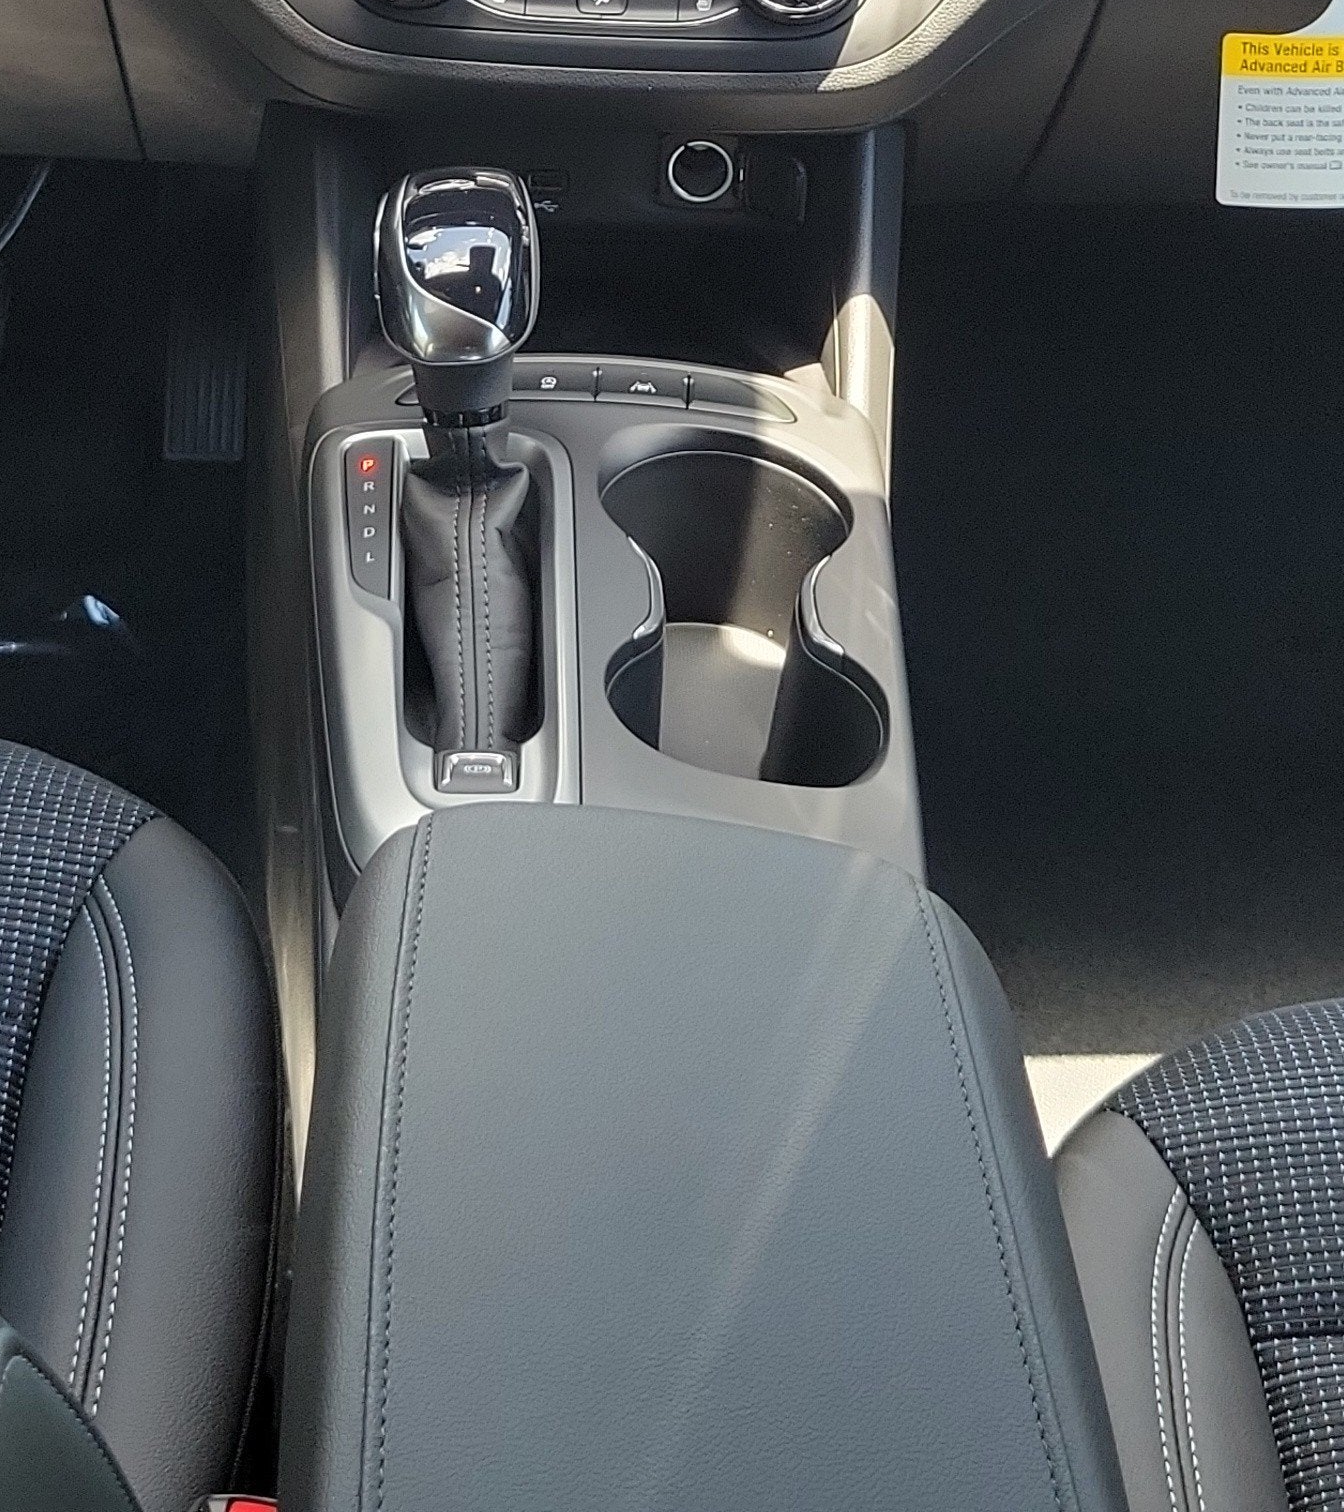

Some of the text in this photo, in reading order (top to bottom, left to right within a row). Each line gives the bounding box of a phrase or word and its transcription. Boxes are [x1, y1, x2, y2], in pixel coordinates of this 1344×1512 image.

[1241, 41, 1269, 56] This
[1274, 42, 1323, 56] Vehicle
[1328, 43, 1339, 56] is
[1240, 59, 1307, 73] Advanced
[1312, 59, 1332, 73] Air
[1237, 85, 1260, 95] Even
[1285, 86, 1331, 96] Advanced
[362, 459, 375, 471] P
[363, 481, 375, 492] R
[363, 503, 376, 515] N
[363, 526, 376, 539] D
[366, 551, 375, 563] L
